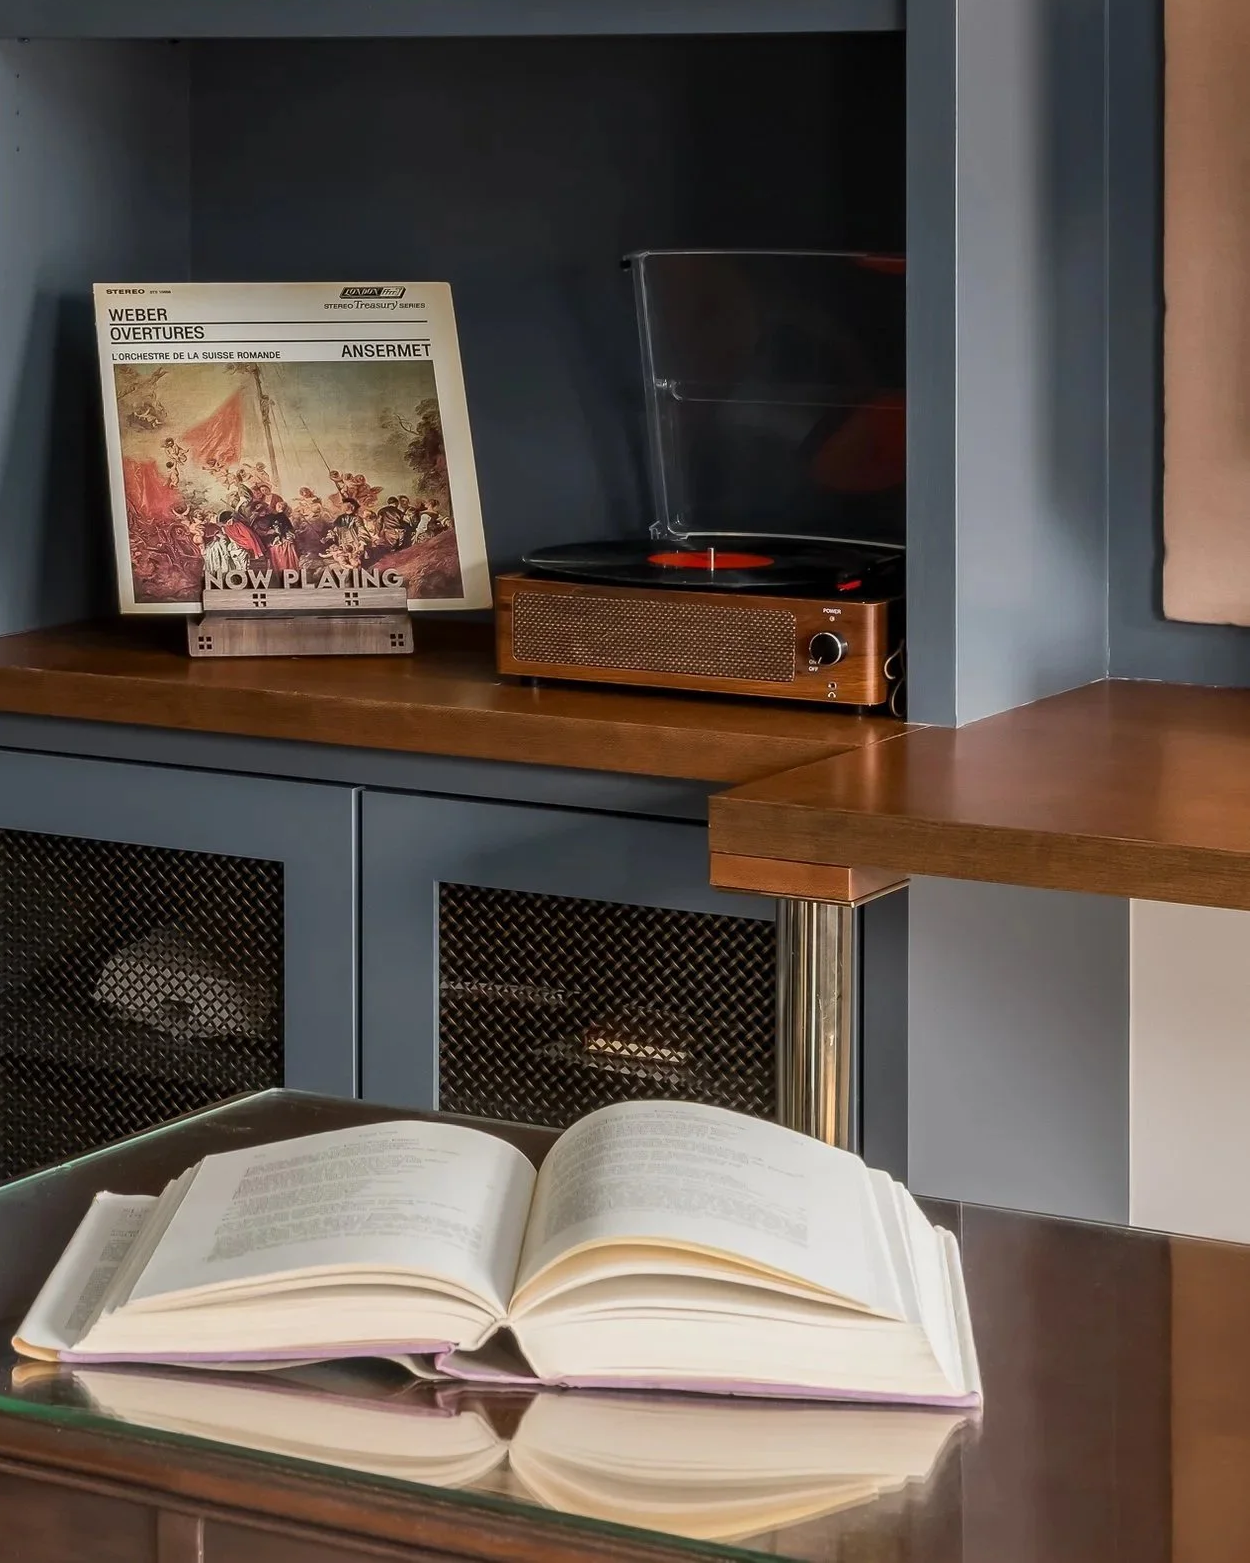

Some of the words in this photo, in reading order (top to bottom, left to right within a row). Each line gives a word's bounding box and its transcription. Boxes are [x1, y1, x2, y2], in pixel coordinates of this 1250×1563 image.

[354, 300, 398, 310] Treasury
[108, 308, 168, 322] WEBER
[110, 326, 205, 341] OVERTURES
[112, 352, 171, 361] L'ORCHESTRE
[173, 352, 185, 360] DE
[187, 352, 199, 360] LA
[202, 351, 234, 360] SUISSE
[237, 351, 281, 360] ROMANDE
[341, 343, 431, 358] ANSERMET
[205, 569, 273, 589] NOW
[283, 568, 404, 589] PLAYING
[823, 607, 842, 615] POWER
